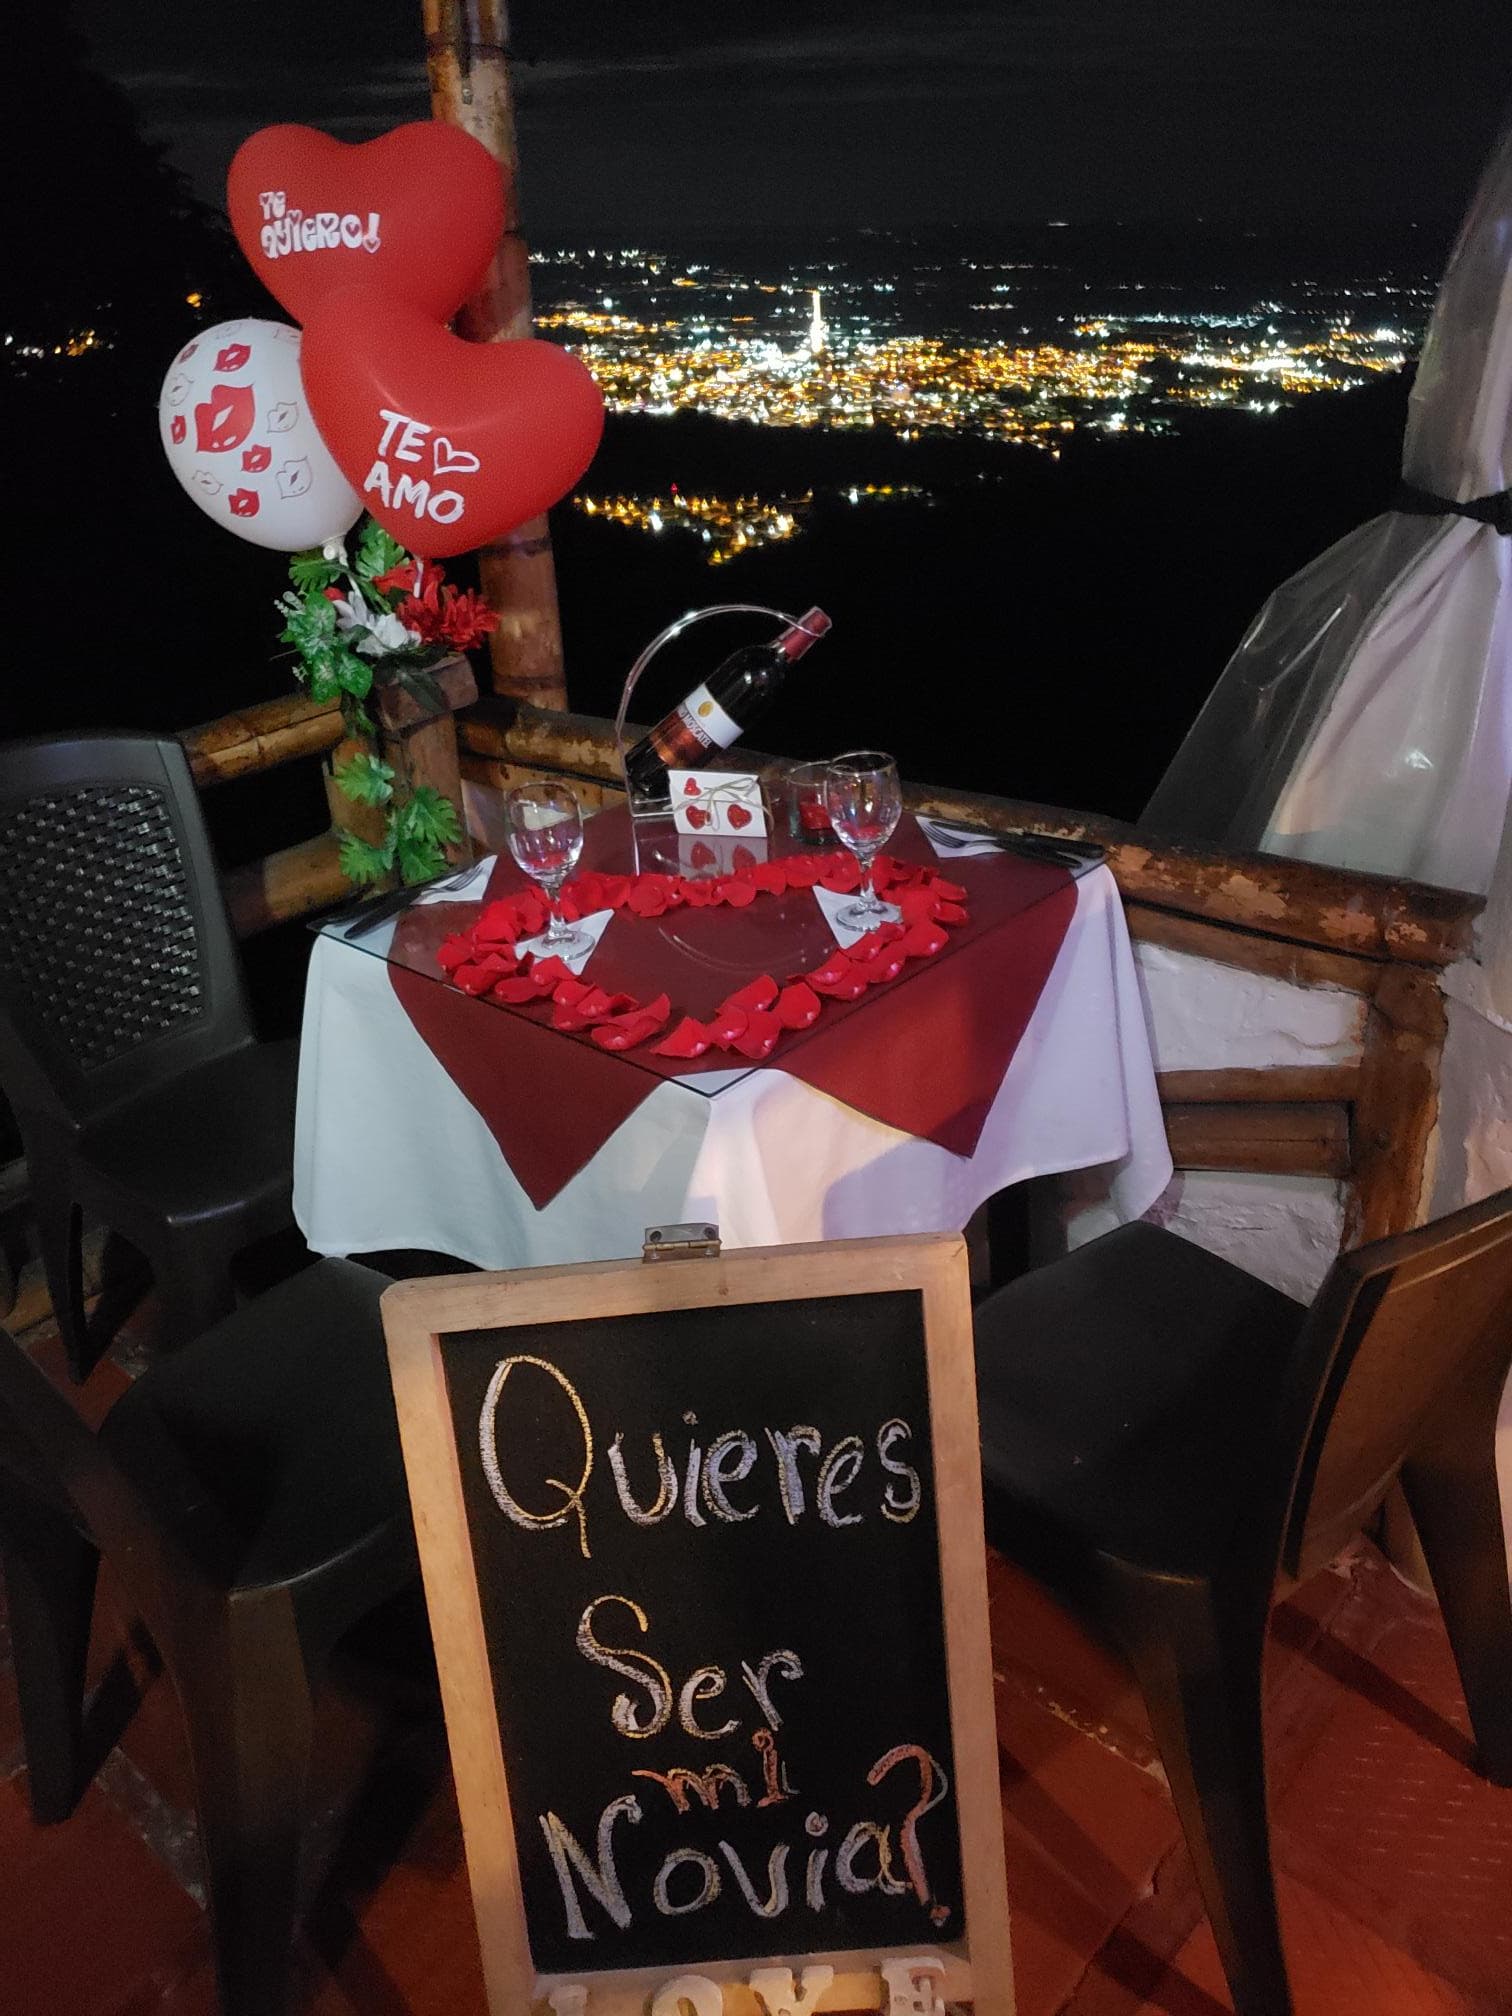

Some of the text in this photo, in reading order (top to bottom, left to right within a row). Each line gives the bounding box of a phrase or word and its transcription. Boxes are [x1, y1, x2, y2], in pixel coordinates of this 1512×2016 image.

[363, 460, 465, 524] AMO
[378, 409, 433, 463] TE
[479, 1354, 922, 1559] Quieres
[576, 1594, 804, 1739] Ser
[538, 1744, 949, 1940] Novia?
